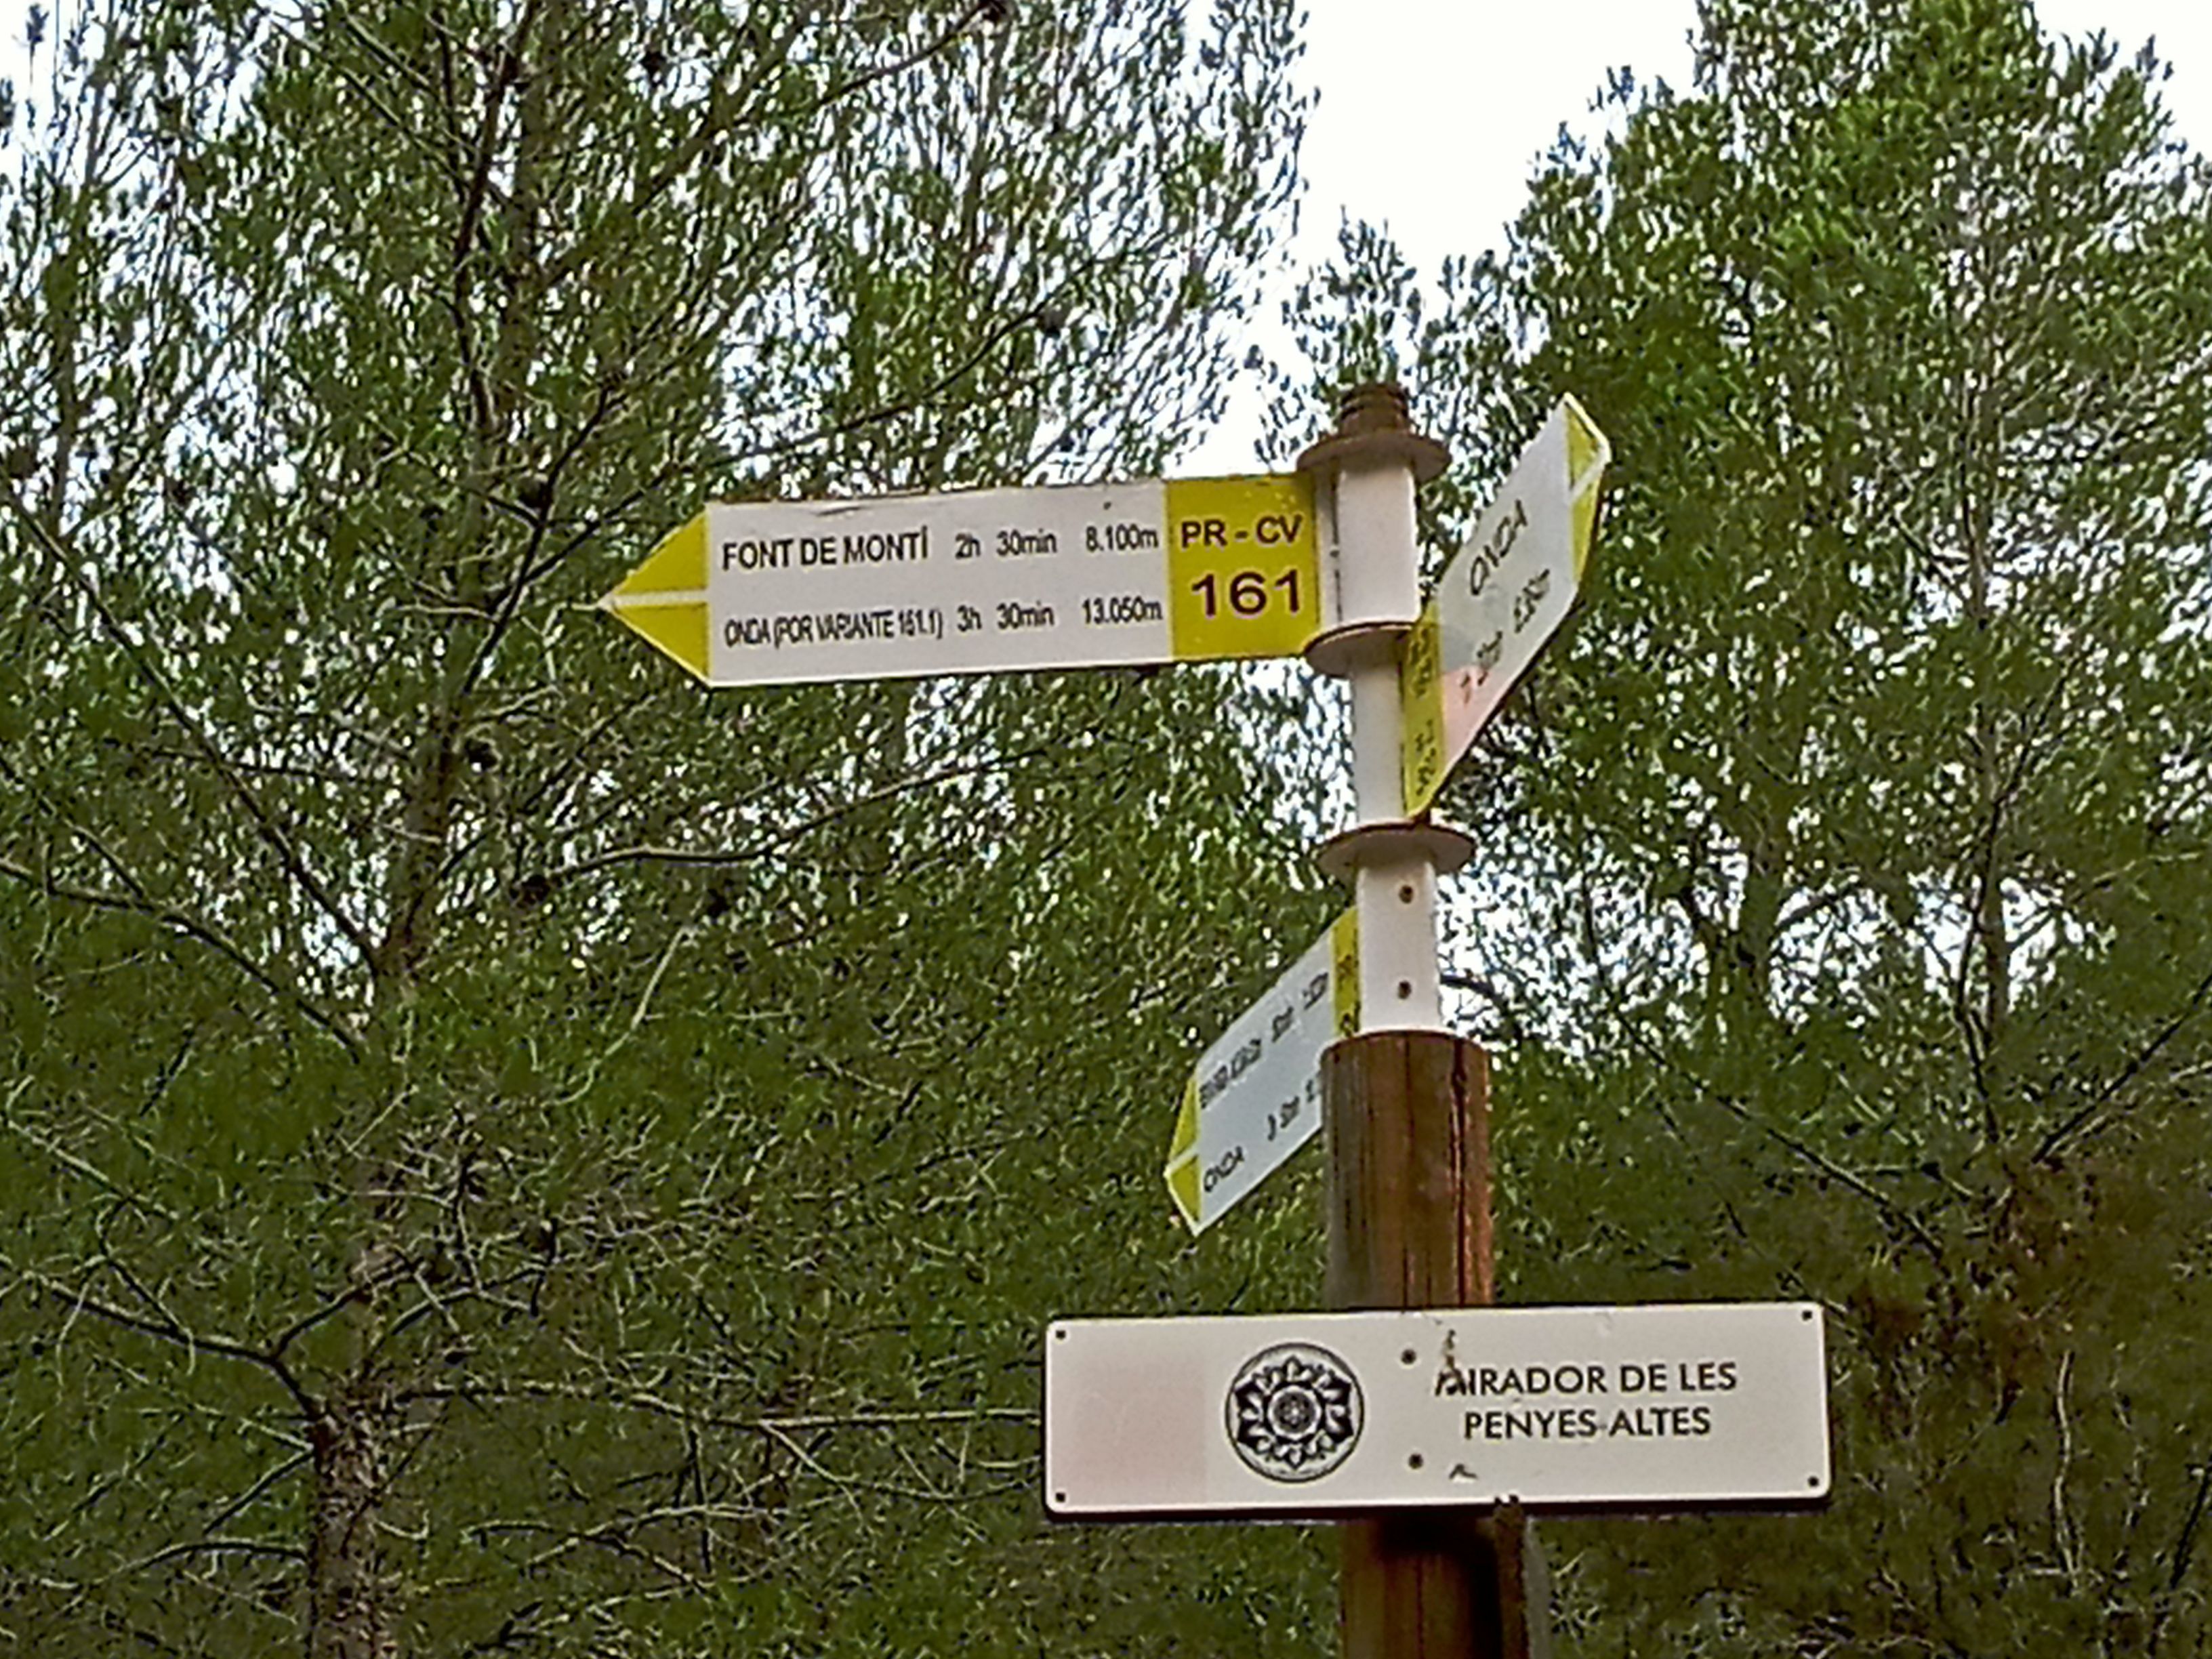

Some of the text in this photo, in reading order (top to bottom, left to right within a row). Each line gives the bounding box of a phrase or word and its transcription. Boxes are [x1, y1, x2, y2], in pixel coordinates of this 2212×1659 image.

[722, 523, 1159, 570] FONT DE MONTÍ 2h 30min 8.100m
[1191, 569, 1300, 618] 161
[956, 605, 982, 632] 3h
[996, 600, 1055, 630] 30min
[1081, 596, 1163, 625] 13.050m
[1619, 1364, 1667, 1393] DE
[1679, 1361, 1738, 1391] LES
[1464, 1406, 1711, 1441] PENYES ALTES
